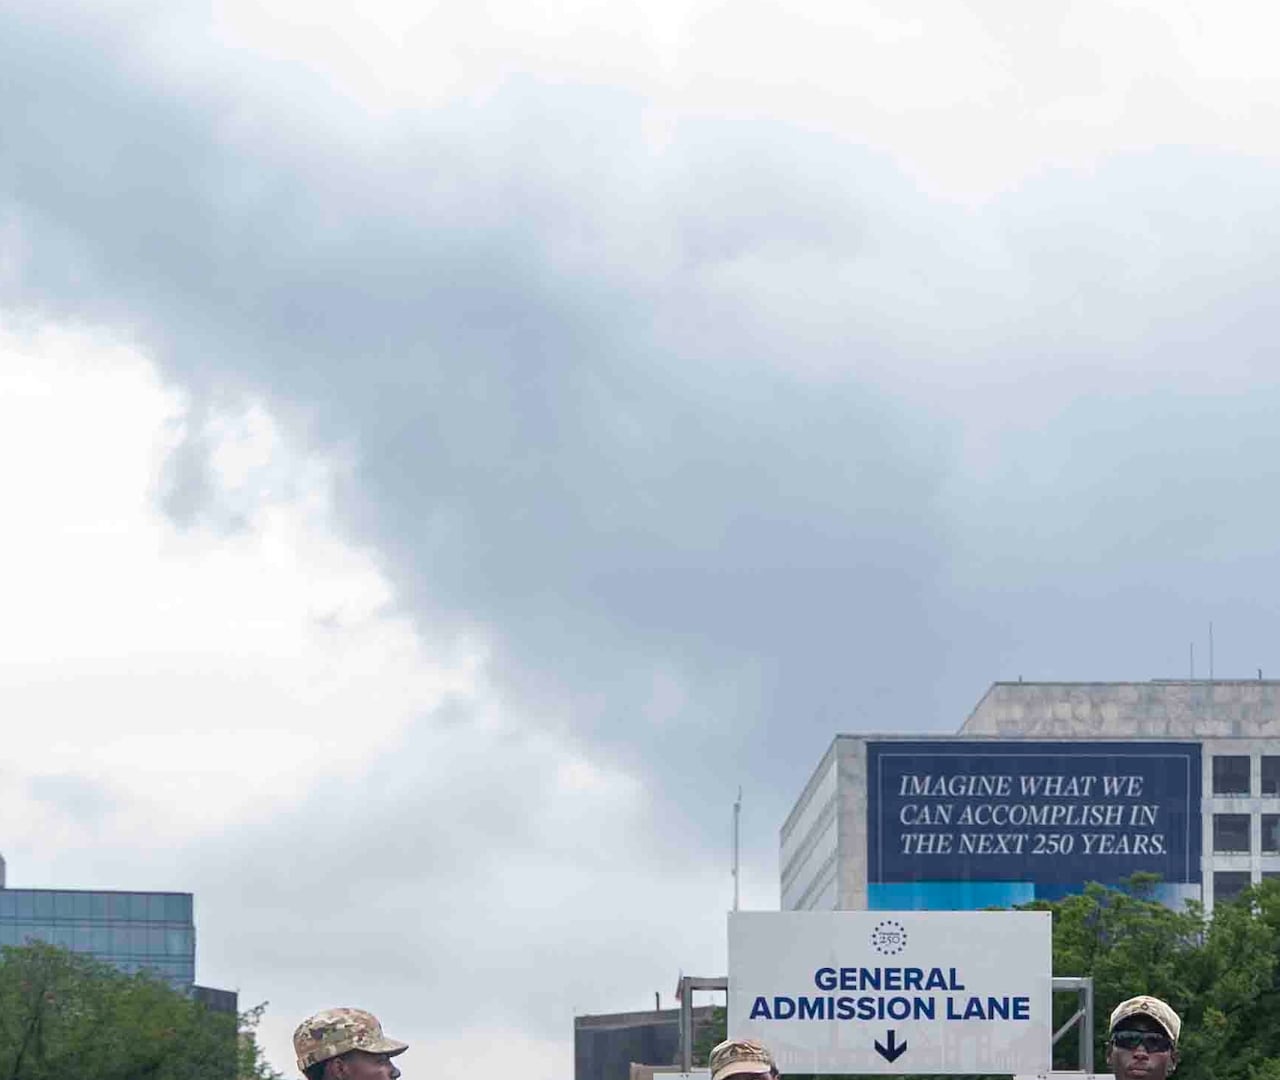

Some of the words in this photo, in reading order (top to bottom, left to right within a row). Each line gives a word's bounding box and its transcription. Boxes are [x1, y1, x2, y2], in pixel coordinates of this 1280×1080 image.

[900, 775, 1012, 797] IMAGINE
[1020, 776, 1097, 796] WHAT
[1103, 776, 1143, 796] WE
[900, 804, 953, 825] CAN
[958, 804, 1124, 825] ACCOMPLISH
[1130, 805, 1158, 825] IN
[901, 833, 953, 854] THE
[959, 833, 1029, 854] NEXT
[1032, 834, 1074, 855] 250
[1081, 834, 1167, 856] YEARS.
[814, 967, 966, 991] GENERAL
[749, 996, 935, 1021] ADMISSION
[947, 996, 1030, 1021] LANE
